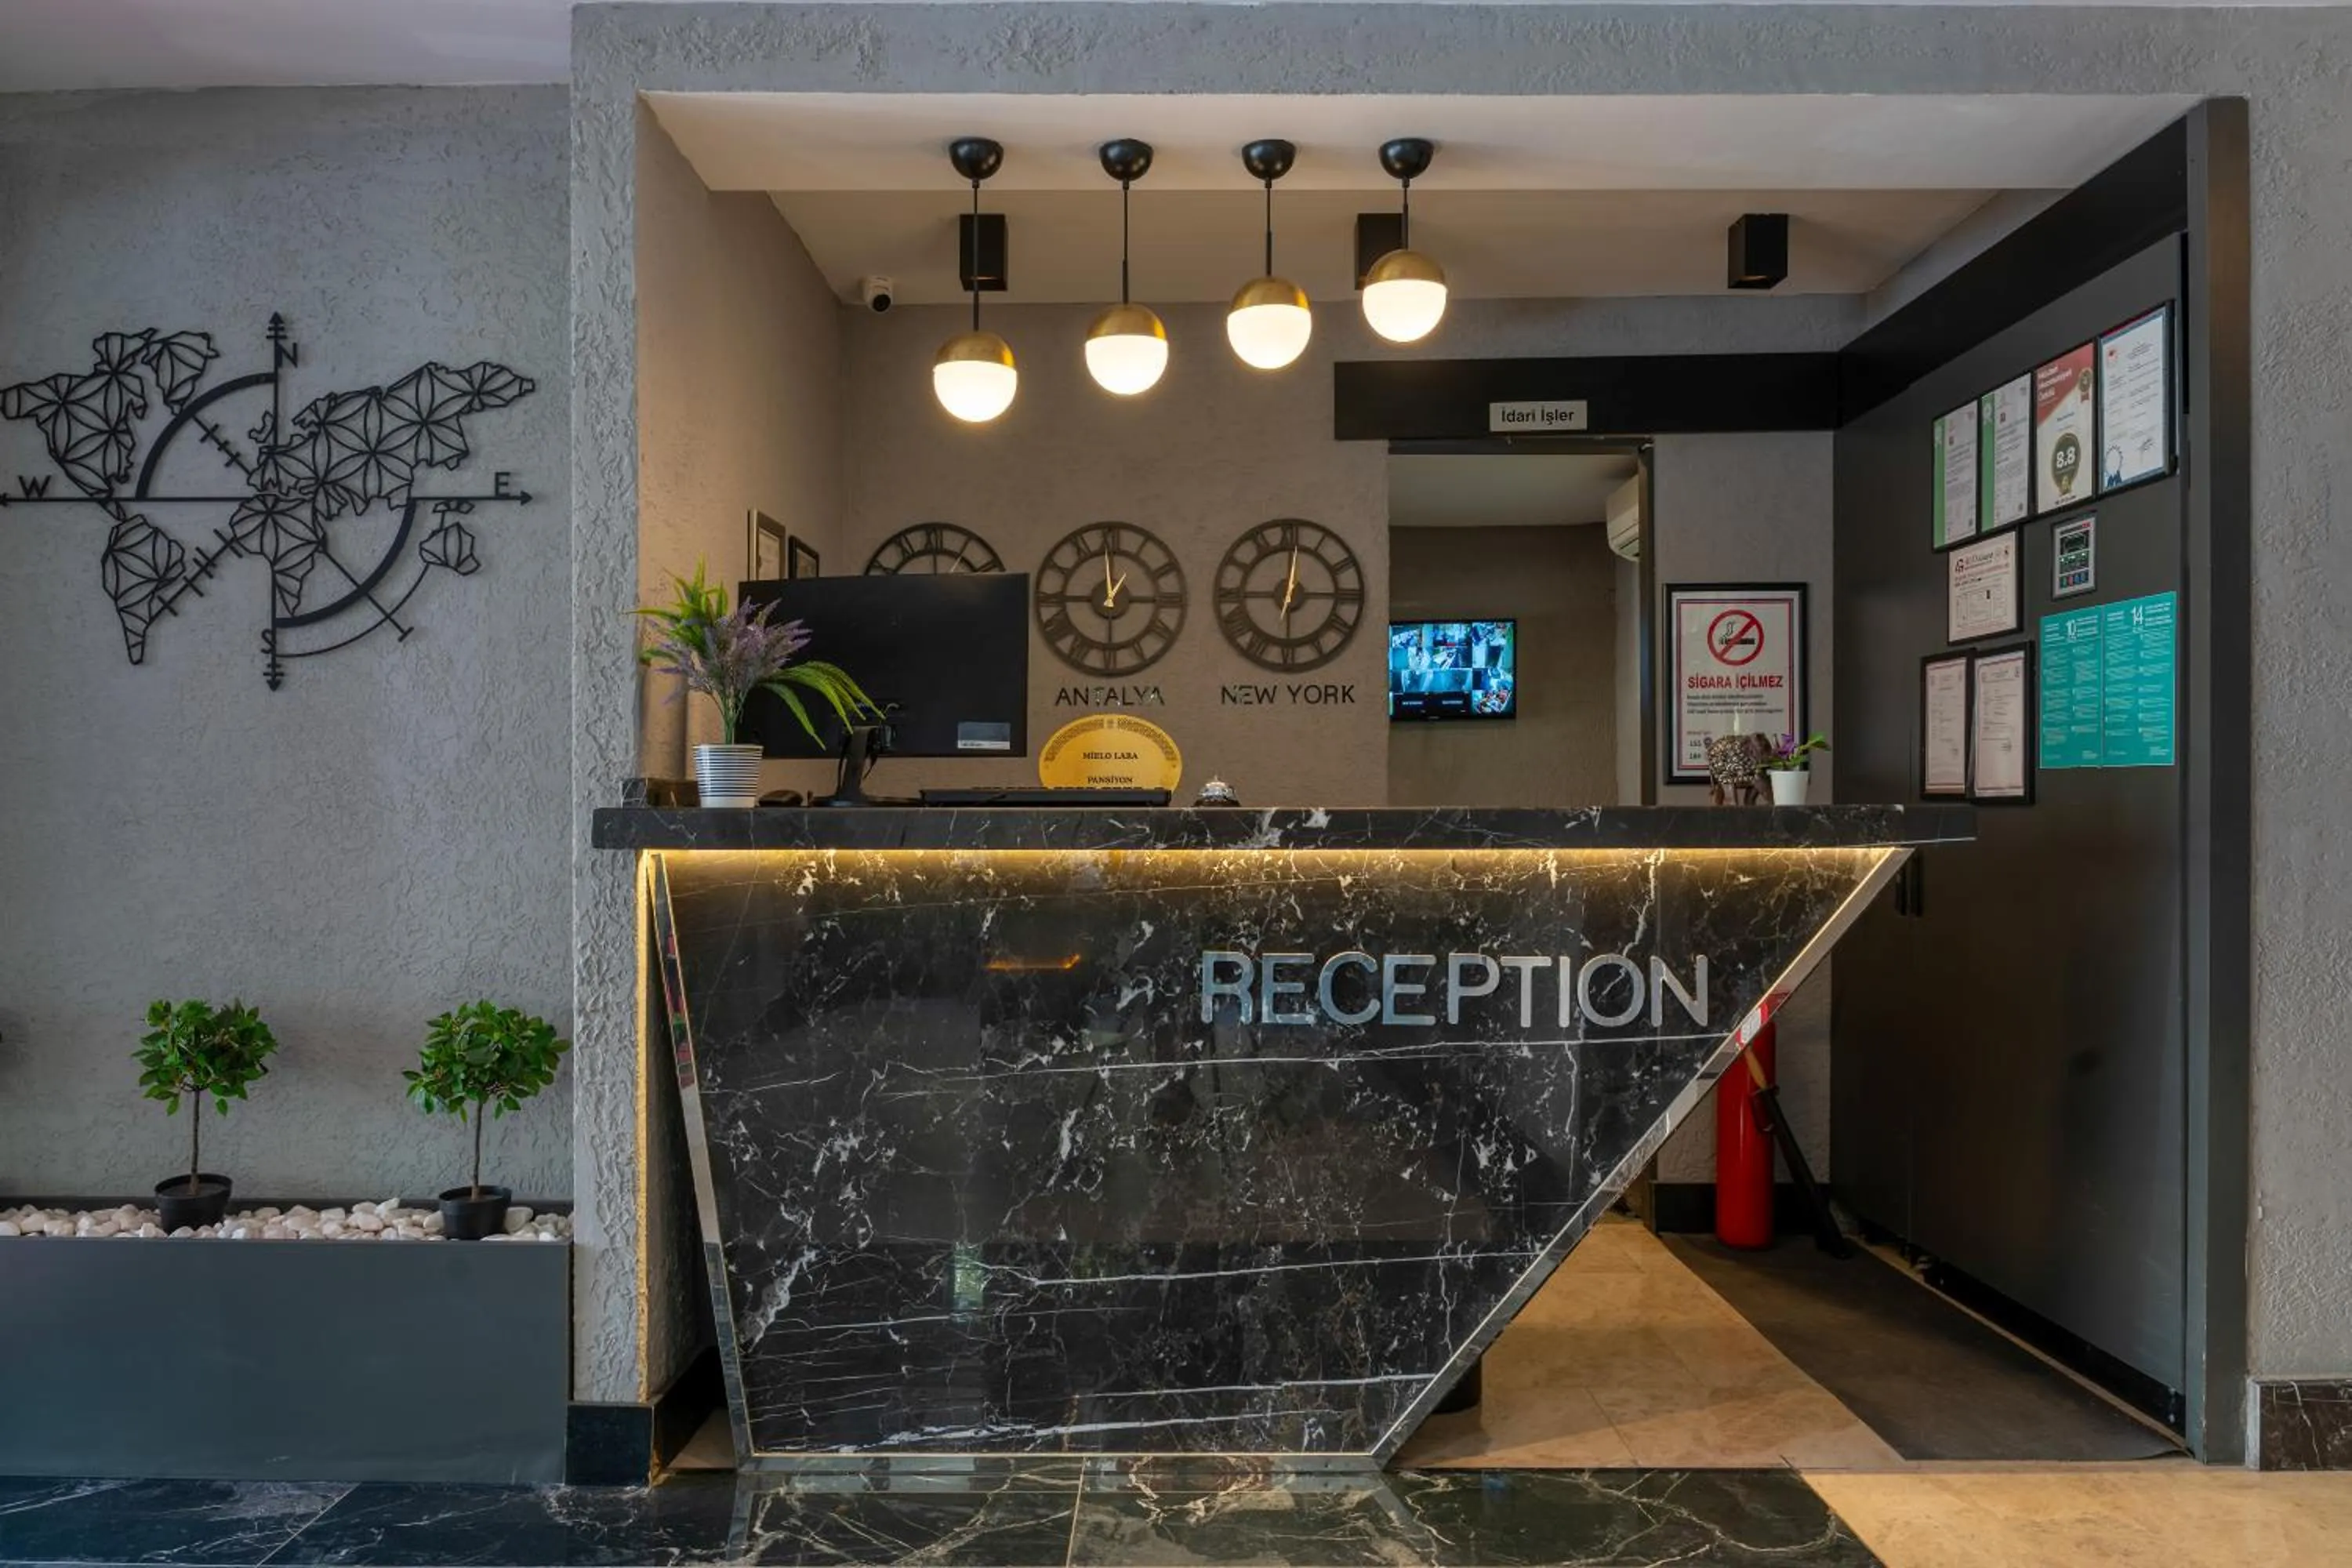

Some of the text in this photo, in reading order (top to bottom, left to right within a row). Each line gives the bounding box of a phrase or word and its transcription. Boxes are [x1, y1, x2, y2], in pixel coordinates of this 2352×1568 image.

[274, 342, 297, 368] N
[1501, 405, 1574, 425] İdari İşler
[2056, 445, 2075, 468] 8.8
[18, 474, 52, 500] W
[495, 471, 510, 499] E
[1687, 673, 1784, 691] SİGARA İÇİLMEZ
[1055, 686, 1165, 706] ANTALYA
[1221, 684, 1356, 704] NEW YORK
[1087, 775, 1134, 785] PANSİYON
[1200, 950, 1709, 1027] RECEPTION
